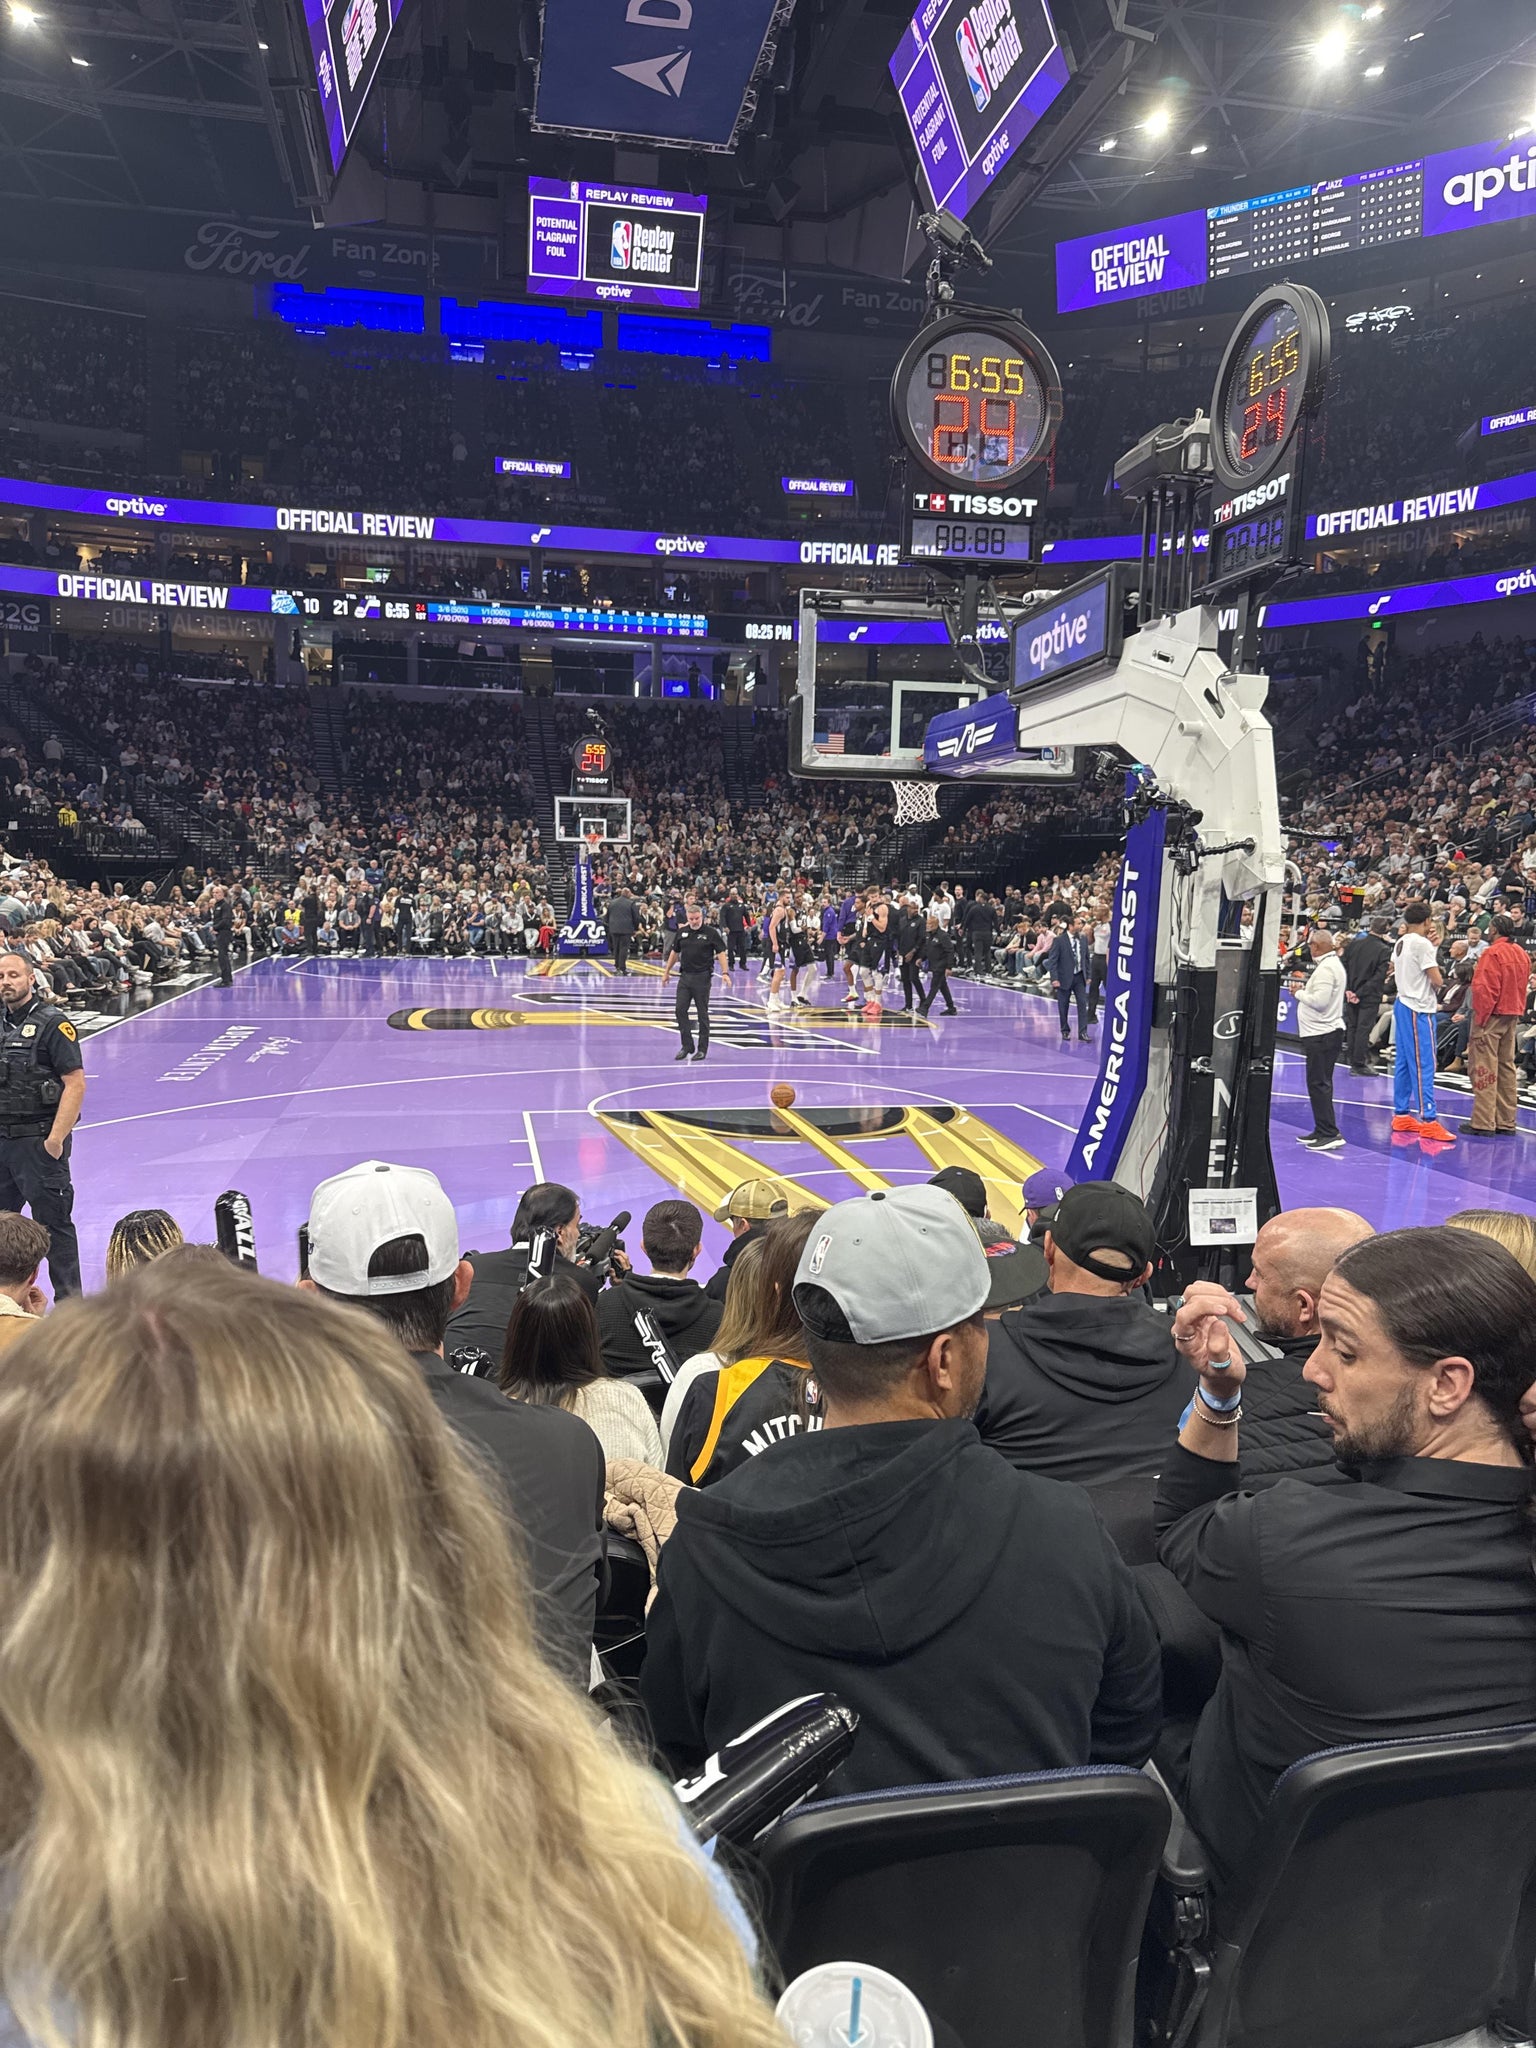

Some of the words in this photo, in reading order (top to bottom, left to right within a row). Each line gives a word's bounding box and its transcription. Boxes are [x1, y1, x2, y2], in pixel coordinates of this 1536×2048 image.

[982, 16, 1024, 91] Center
[911, 82, 940, 130] POTENTIAL
[919, 102, 947, 151] FLAGRANT
[931, 136, 948, 165] FOUL
[981, 132, 1011, 176] aptive
[1326, 179, 1343, 190] JAZZ
[585, 188, 629, 203] REPLAY
[631, 194, 674, 208] REVIEW
[1220, 201, 1249, 215] THUNDER
[536, 216, 578, 231] POTENTIAL
[536, 230, 577, 245] FLAGRANT
[632, 223, 675, 253] Replay
[183, 222, 310, 279] Ford
[332, 238, 376, 260] Fan
[382, 243, 440, 268] Zone
[546, 245, 567, 258] FOUL
[631, 247, 673, 273] Center
[1091, 234, 1170, 272] OFFICIAL
[1095, 257, 1166, 293] REVIEW
[595, 285, 632, 298] aptive
[842, 288, 881, 308] Fan
[950, 354, 1024, 395] 6:55
[1249, 331, 1299, 397] 6:55
[933, 394, 1016, 467] 24
[1240, 386, 1289, 459] 24
[1490, 410, 1526, 430] OFFICIAL
[502, 460, 534, 473] OFFICIAL
[535, 463, 563, 475] REVIEW
[788, 480, 818, 491] OFFICIAL
[819, 482, 846, 493] REVIEW
[1233, 474, 1290, 516] TISSOT
[106, 497, 165, 517] aptive
[949, 497, 1038, 517] TISSOT
[1316, 503, 1399, 536] OFFICIAL
[1403, 486, 1479, 523] REVIEW
[276, 507, 359, 535] OFFICIAL
[362, 513, 434, 539] REVIEW
[655, 536, 706, 555] aptive
[800, 542, 873, 565] OFFICIAL
[57, 574, 148, 604] OFFICIAL
[151, 582, 228, 609] REVIEW
[303, 598, 320, 614] 10
[333, 600, 348, 615] 21
[385, 602, 410, 619] 6:55
[416, 603, 426, 612] 24
[746, 623, 773, 639] 08:25
[775, 625, 792, 641] PM
[1029, 612, 1088, 671] aptive
[585, 744, 606, 755] 6:55
[581, 754, 604, 771] 24
[580, 866, 588, 885] FIRST
[1082, 990, 1131, 1171] AMERICA
[1117, 859, 1140, 982] FIRST
[200, 1031, 255, 1051] DELTA
[155, 1051, 226, 1082] CENTER
[742, 1414, 823, 1456] MITCH
